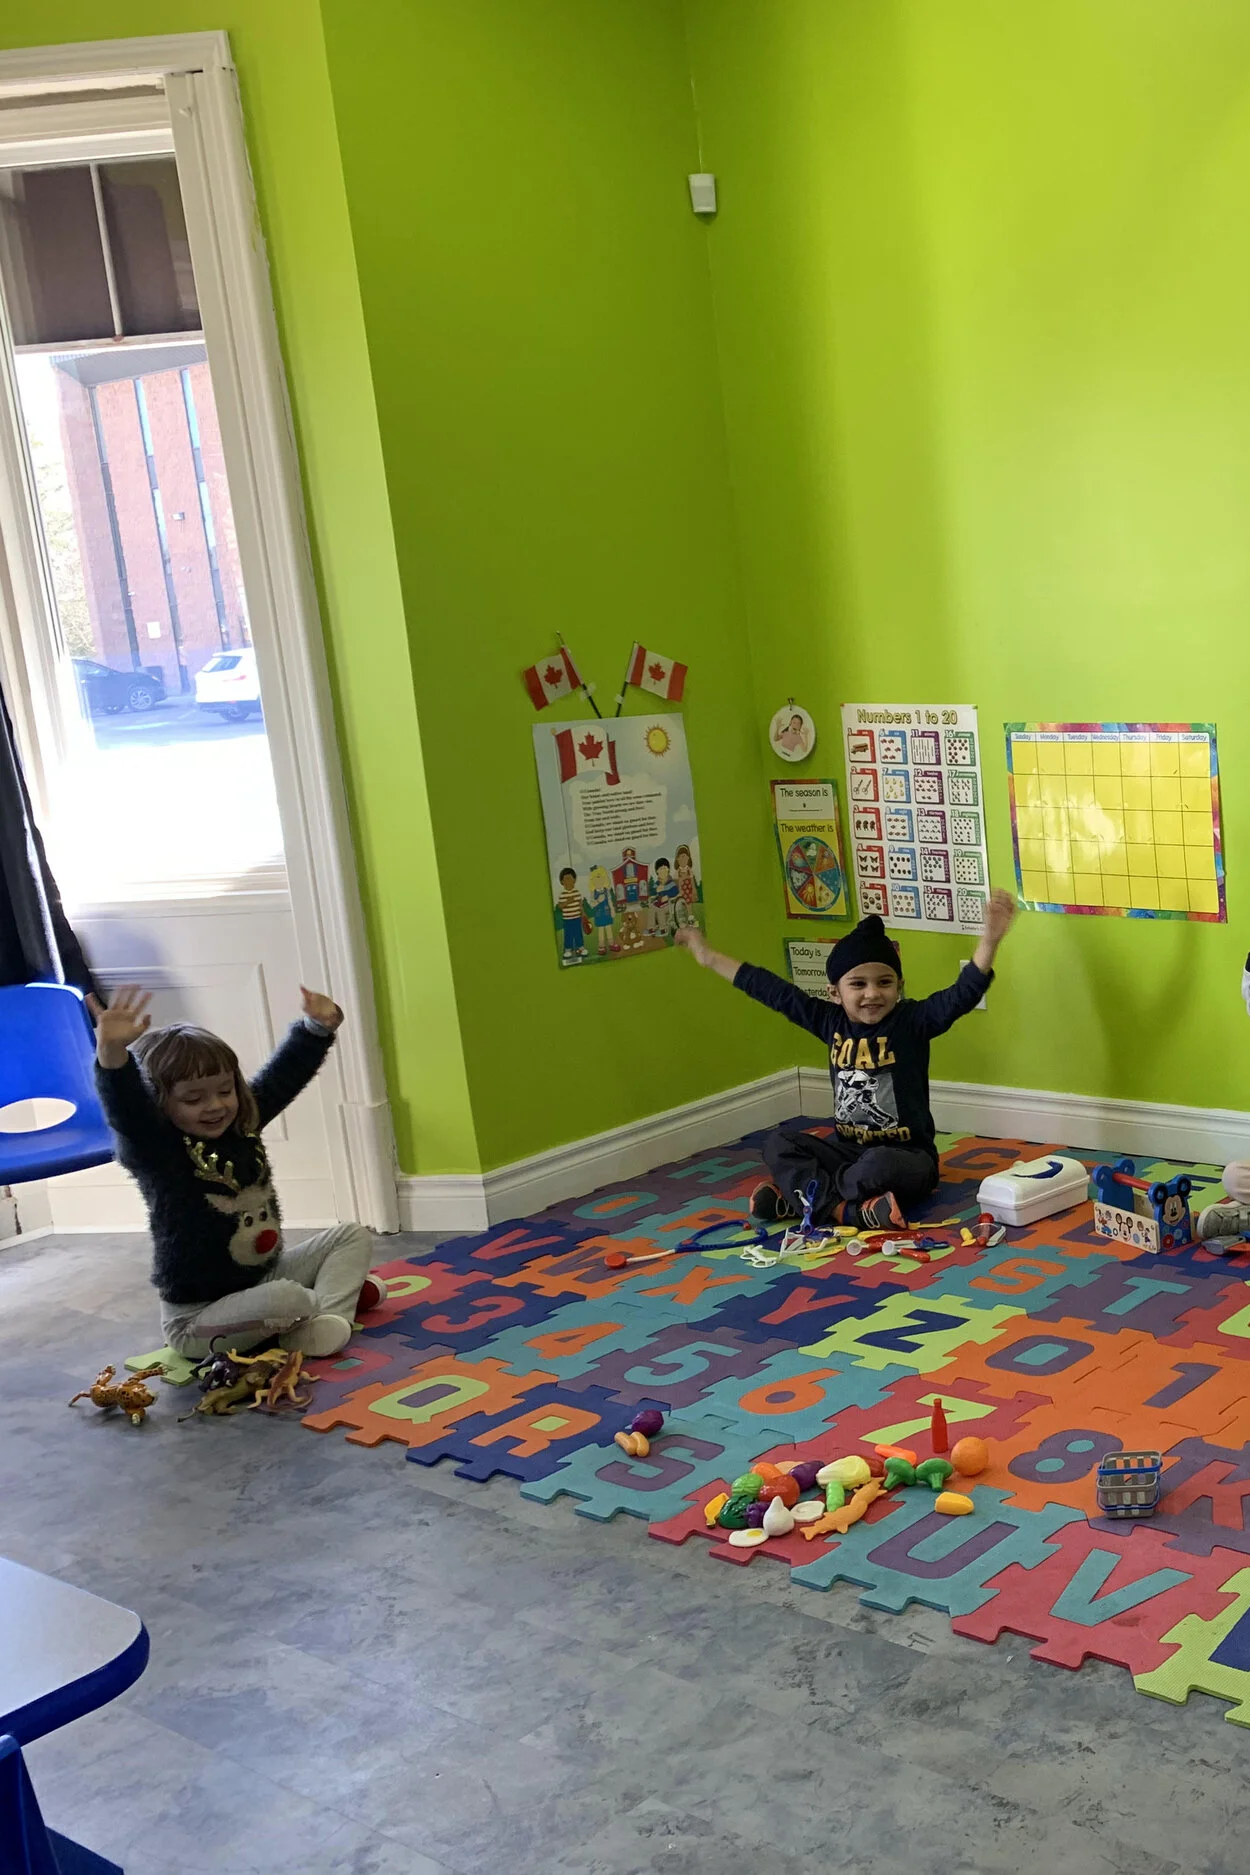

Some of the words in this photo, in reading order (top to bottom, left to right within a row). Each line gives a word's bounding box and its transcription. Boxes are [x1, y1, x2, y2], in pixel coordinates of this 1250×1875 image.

[857, 709, 912, 724] Numbers
[915, 710, 921, 724] 1
[925, 710, 938, 724] to
[942, 710, 958, 725] 20
[1040, 733, 1059, 742] Monday
[1068, 733, 1088, 742] Tuesday
[780, 787, 793, 798] The
[796, 789, 821, 797] season
[822, 788, 829, 797] is
[780, 823, 794, 833] The
[796, 824, 826, 833] weather
[827, 824, 834, 832] is
[791, 946, 814, 959] Today
[815, 948, 821, 957] is
[793, 967, 827, 976] Tomorrow
[830, 1032, 896, 1069] GOAL
[666, 1157, 763, 1183] H
[470, 1229, 565, 1260] V
[637, 1268, 754, 1305] X
[969, 1258, 1067, 1295] S
[759, 1287, 858, 1324] Y
[1102, 1277, 1193, 1315] T
[421, 1296, 526, 1334] 3
[854, 1310, 971, 1353] Z
[523, 1322, 626, 1359] 4
[623, 1342, 743, 1386] 5
[368, 1374, 490, 1424] Q
[738, 1368, 843, 1414] 6
[470, 1403, 601, 1457] R
[859, 1392, 998, 1445] 7
[595, 1434, 725, 1491] S
[1008, 1429, 1123, 1484] 8
[866, 1508, 1021, 1580] U
[1049, 1548, 1194, 1627] V
